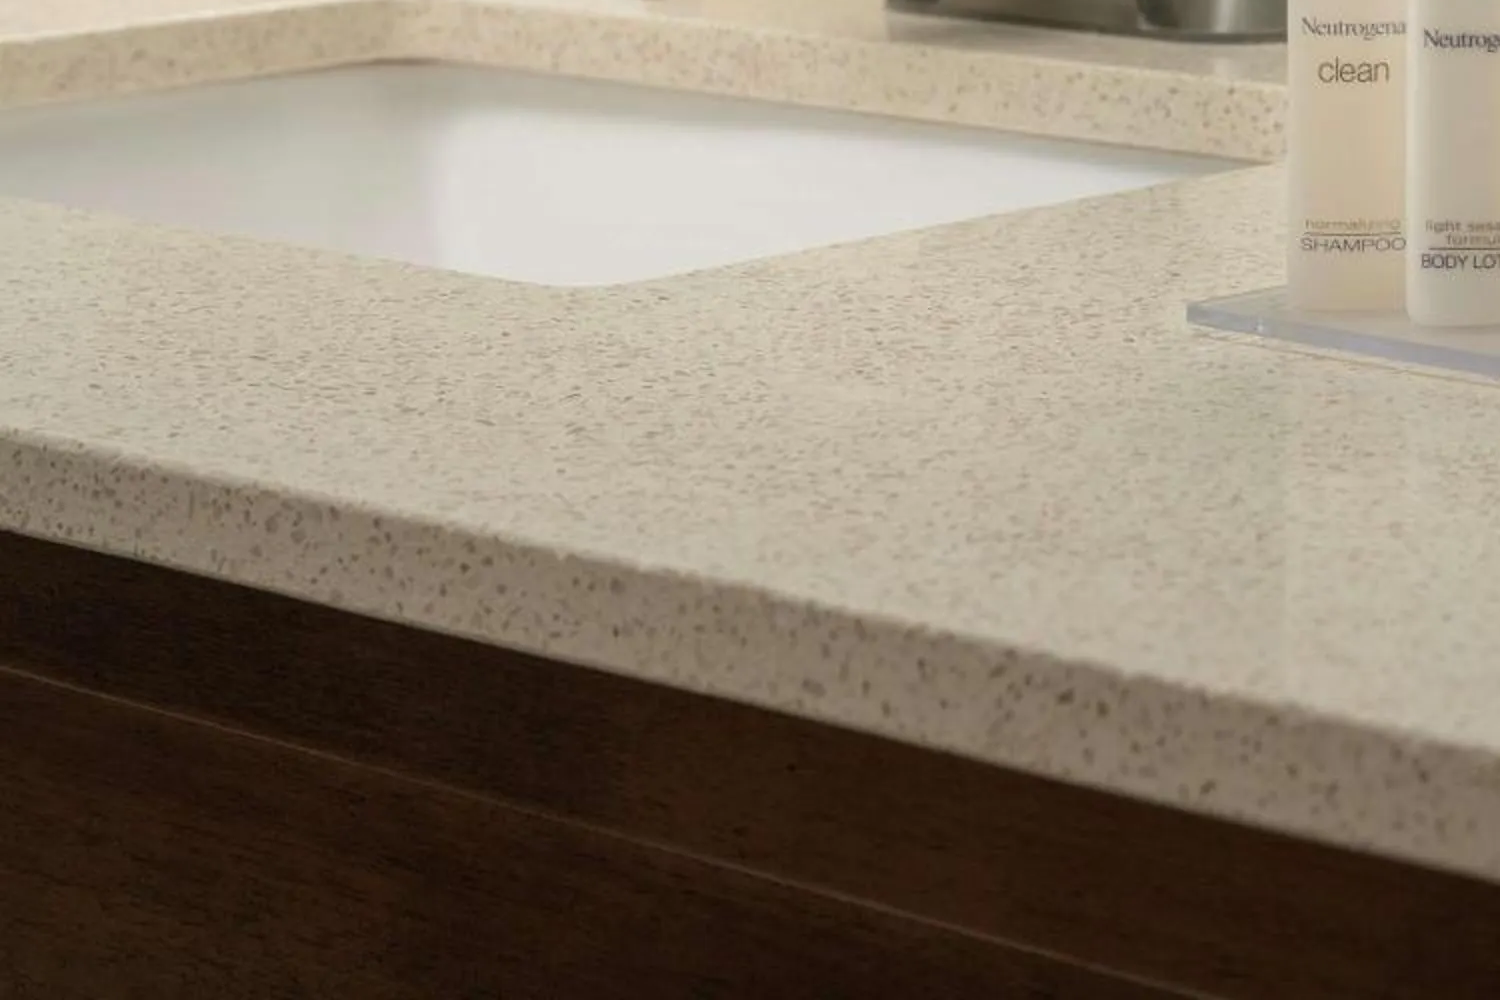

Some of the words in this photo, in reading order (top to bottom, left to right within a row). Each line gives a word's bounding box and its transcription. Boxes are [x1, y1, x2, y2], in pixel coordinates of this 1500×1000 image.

[1301, 16, 1408, 41] Neutrogena
[1318, 56, 1391, 84] clean
[1425, 219, 1463, 233] light
[1300, 236, 1407, 253] SHAMPOO
[1421, 253, 1468, 270] BODY
